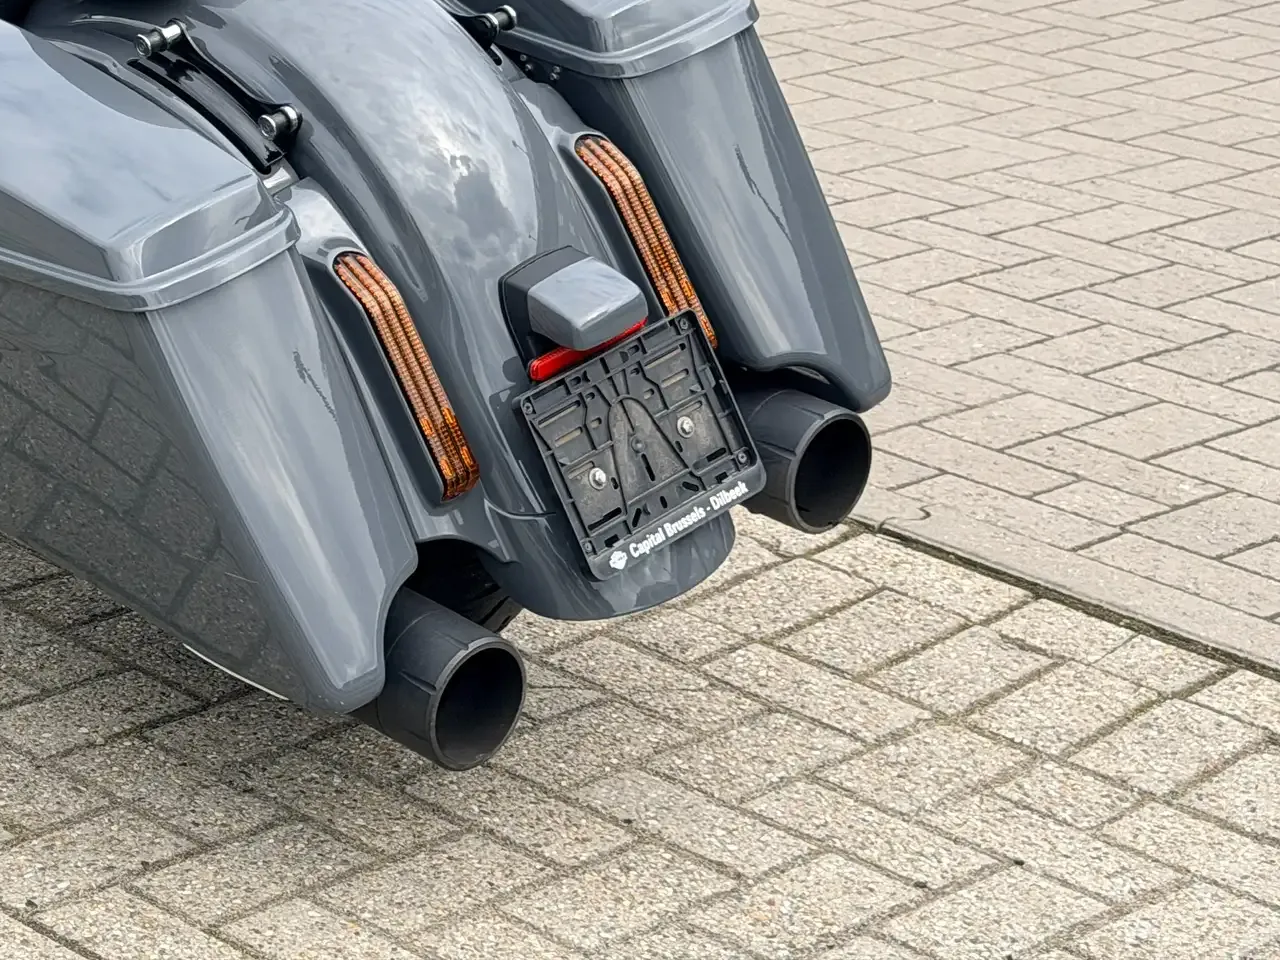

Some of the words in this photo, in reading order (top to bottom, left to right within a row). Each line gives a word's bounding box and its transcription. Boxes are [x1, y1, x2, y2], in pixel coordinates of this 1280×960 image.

[629, 527, 667, 558] Capital
[663, 506, 707, 538] Brussels
[709, 480, 750, 511] Dilbeek
